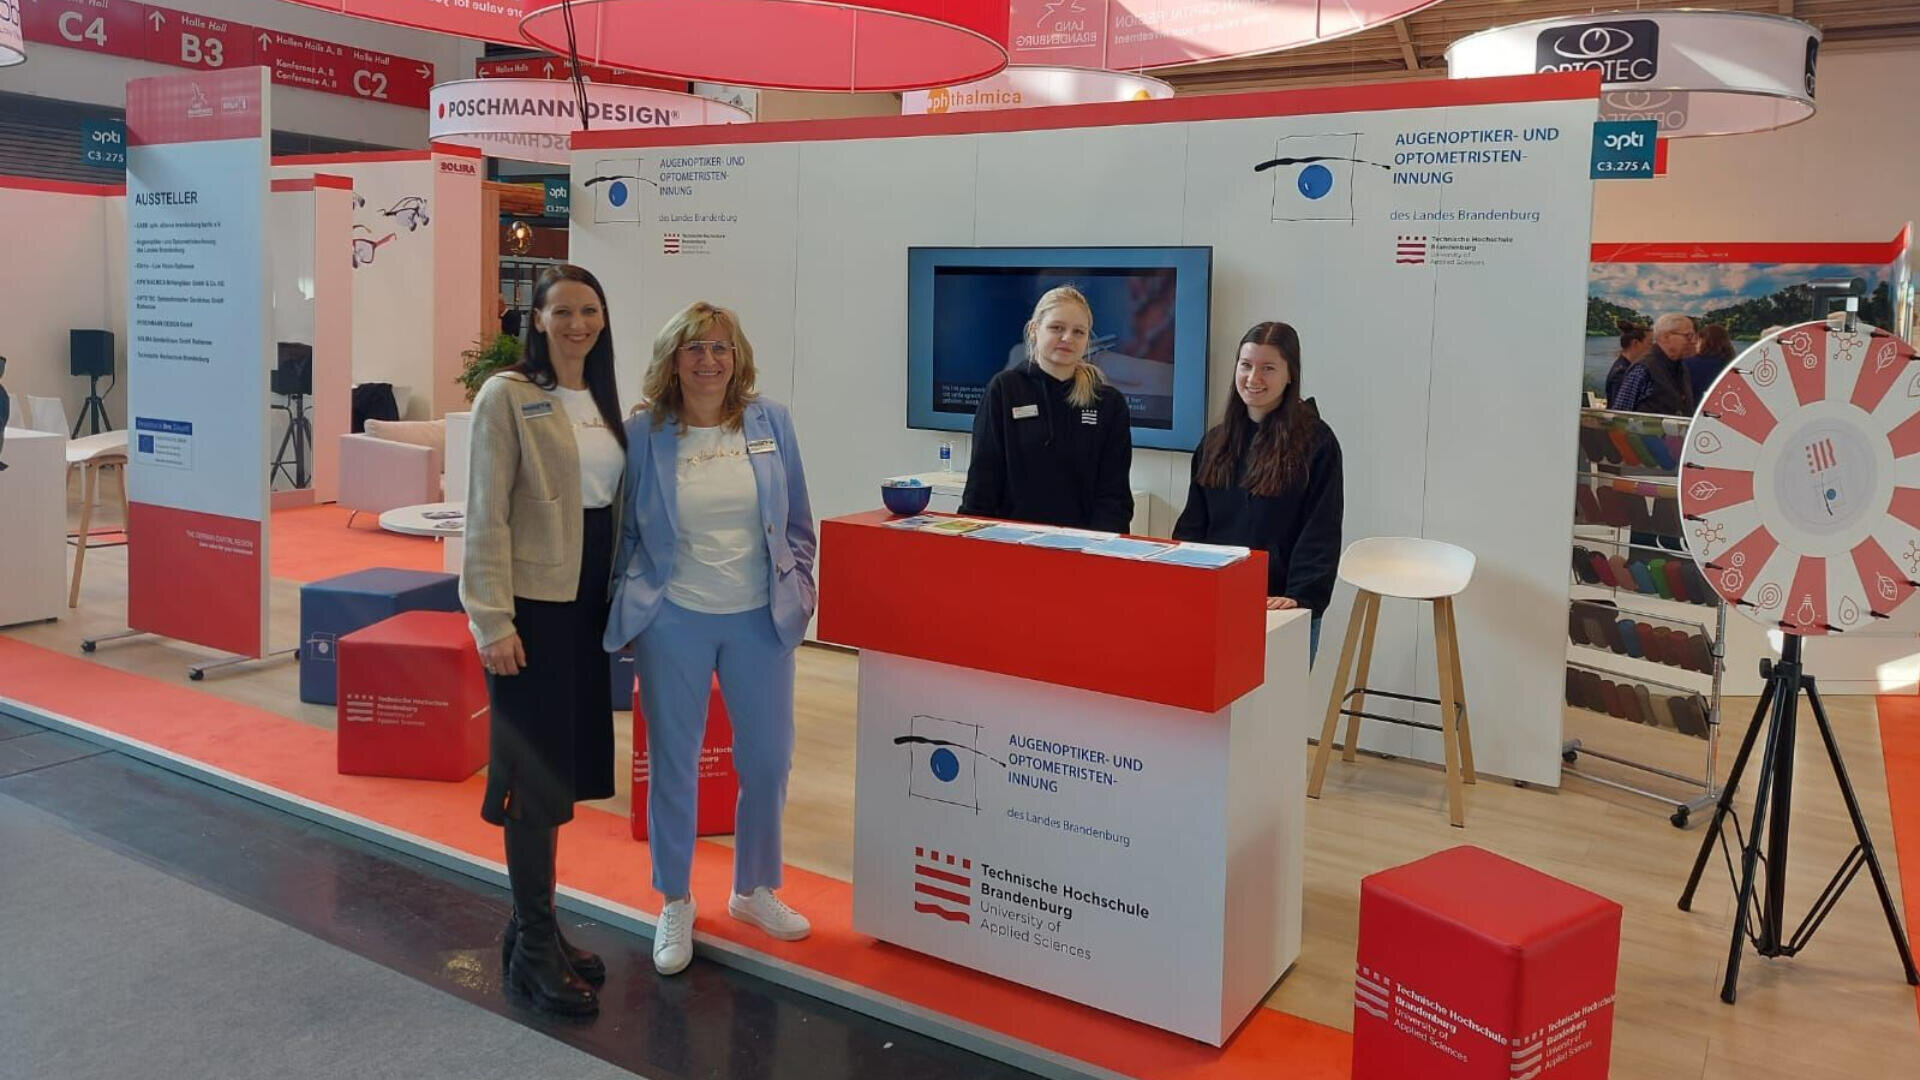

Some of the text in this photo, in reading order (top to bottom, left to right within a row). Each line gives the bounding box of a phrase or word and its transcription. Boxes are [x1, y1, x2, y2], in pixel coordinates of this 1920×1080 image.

[58, 11, 107, 46] C4
[182, 15, 228, 32] Halle Hall
[181, 33, 223, 67] B3
[353, 69, 388, 99] C2
[449, 98, 575, 118] POSCHMANN
[92, 130, 121, 144] opti
[1395, 128, 1559, 146] AUGENOPTIKER- UND
[1604, 131, 1644, 150] opti
[88, 151, 124, 163] C3.275
[440, 161, 476, 174] SOLIRA
[726, 156, 745, 166] UND
[1394, 150, 1528, 165] OPTOMETRISTEN-
[1597, 162, 1651, 171] C3.275 A
[1393, 172, 1453, 184] INNUNG
[136, 191, 198, 206] AUSSTELLER
[659, 186, 692, 196] INNUNG
[1390, 209, 1540, 222] des Landes Brandenburg
[1009, 734, 1143, 771] AUGENOPTIKER- UND
[1008, 753, 1118, 785] OPTOMETRISTEN-
[1008, 771, 1058, 792] INNUNG
[1007, 808, 1130, 848] des Landes Brandenburg
[981, 863, 1150, 919] Technische Hochschule
[981, 883, 1072, 920] Brandenburg
[980, 901, 1062, 933] University of
[980, 918, 1092, 960] Applied Sciences
[1394, 1007, 1449, 1041] University of
[1395, 996, 1457, 1034] Brandenburg
[1396, 983, 1508, 1046] Technische Hochschule
[1393, 1019, 1469, 1063] Applied Sciences
